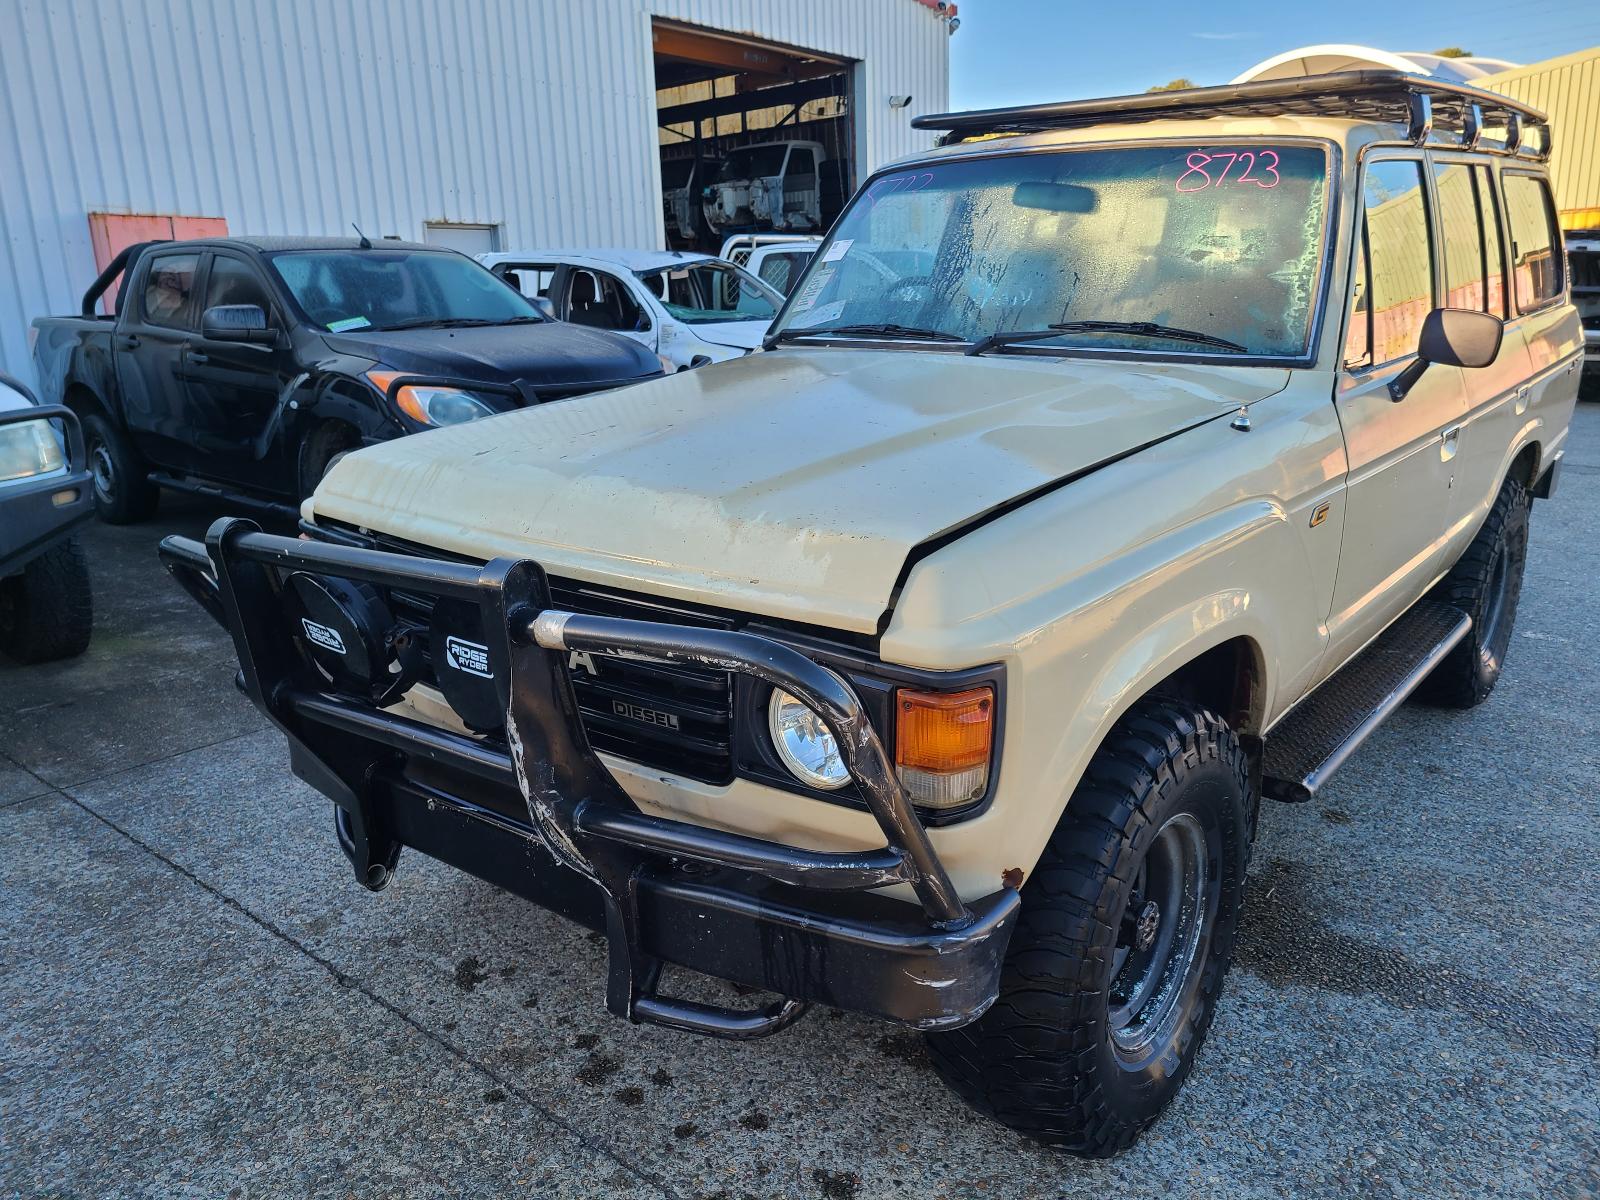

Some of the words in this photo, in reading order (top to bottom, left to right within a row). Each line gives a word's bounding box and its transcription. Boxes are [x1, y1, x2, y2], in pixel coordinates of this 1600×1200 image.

[1175, 150, 1280, 193] 8723
[450, 643, 488, 664] RIDGE
[458, 656, 488, 672] RYDER
[613, 700, 680, 730] DIESEL
